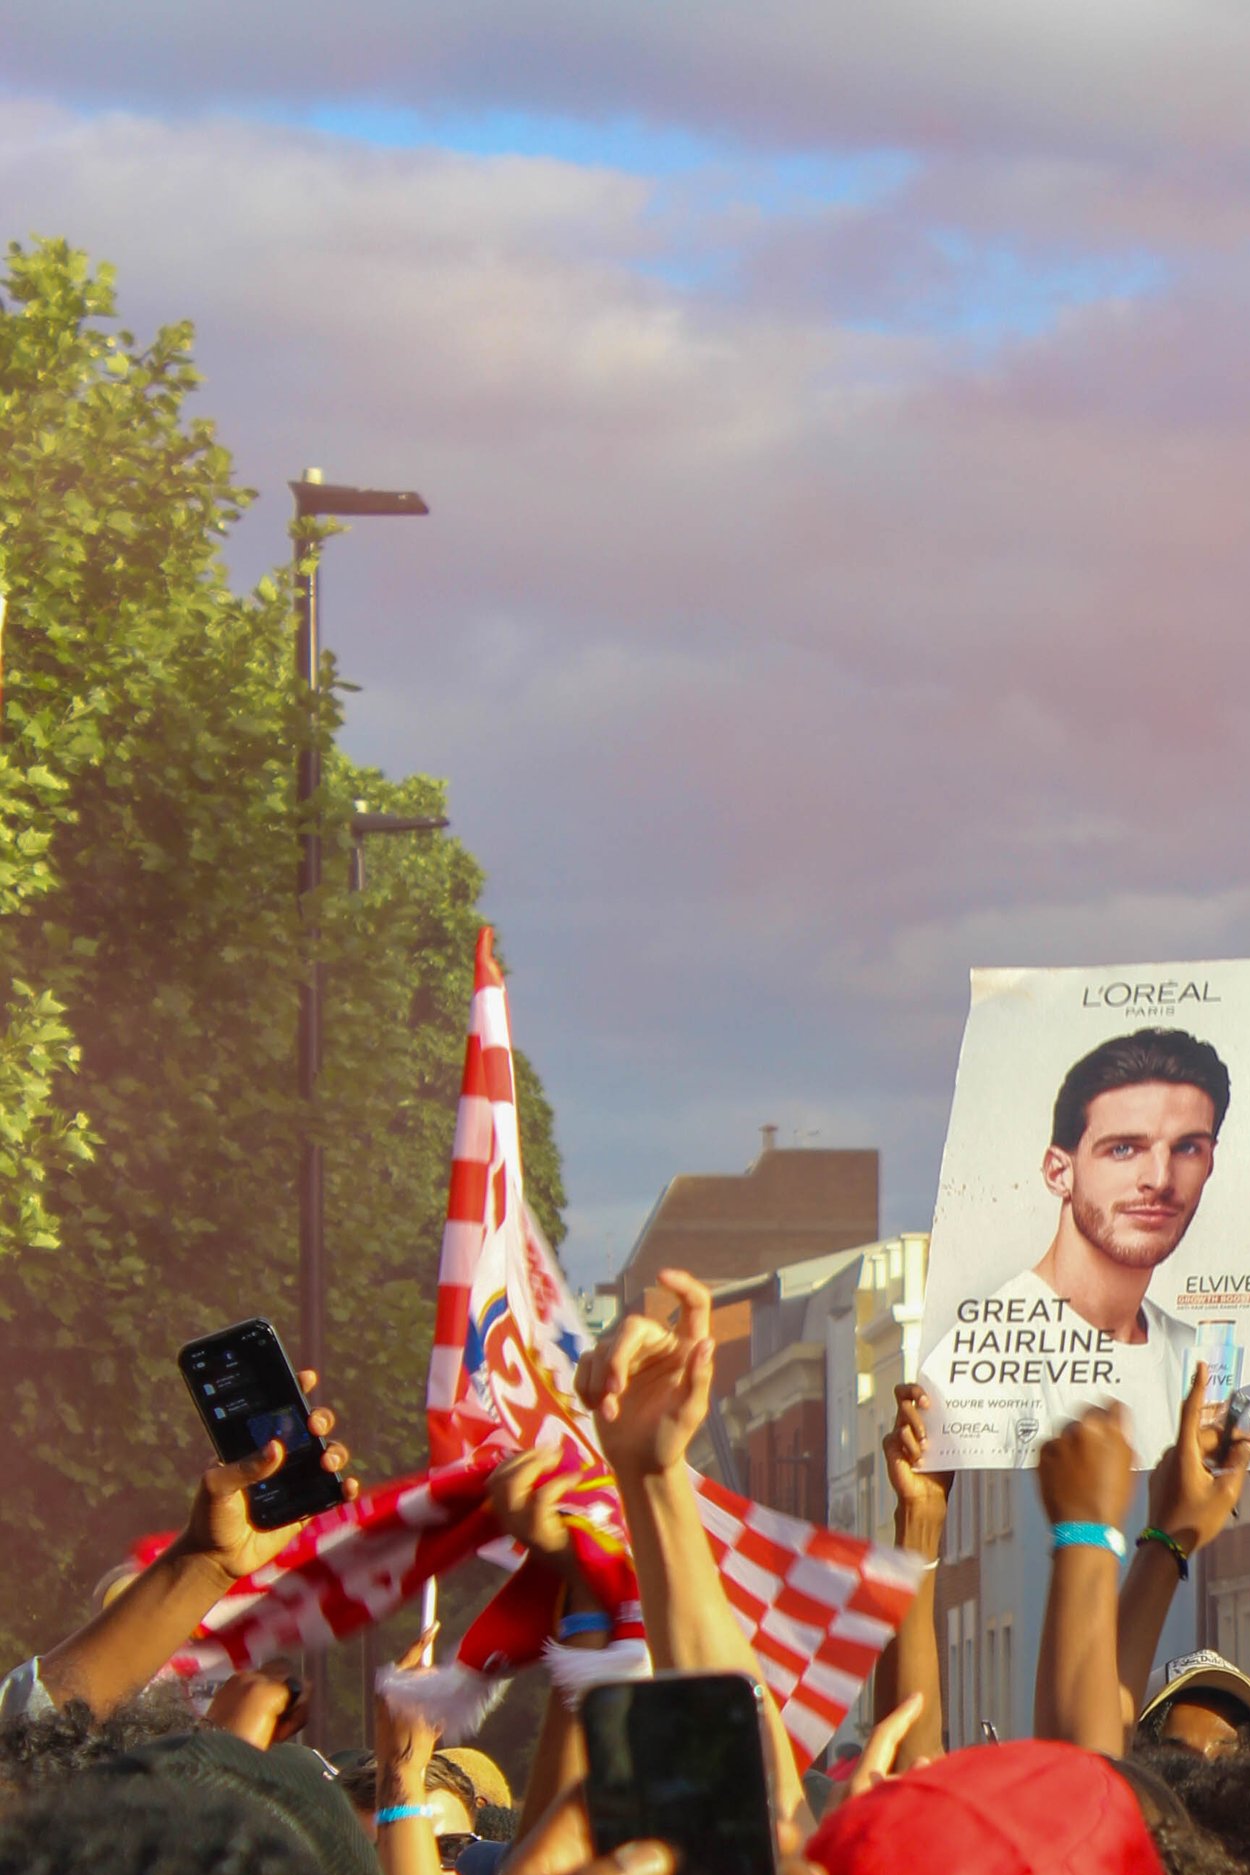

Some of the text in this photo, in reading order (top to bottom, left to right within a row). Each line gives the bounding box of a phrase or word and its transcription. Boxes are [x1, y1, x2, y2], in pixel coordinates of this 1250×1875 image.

[1083, 980, 1222, 1008] L'ORÉAL
[1125, 1006, 1176, 1017] PARIS
[957, 1298, 1071, 1323] GREAT
[953, 1329, 1116, 1354] HAIRLINE
[949, 1360, 1121, 1384] FOREVER.
[945, 1399, 1043, 1409] YOU'RE WORTH IT.
